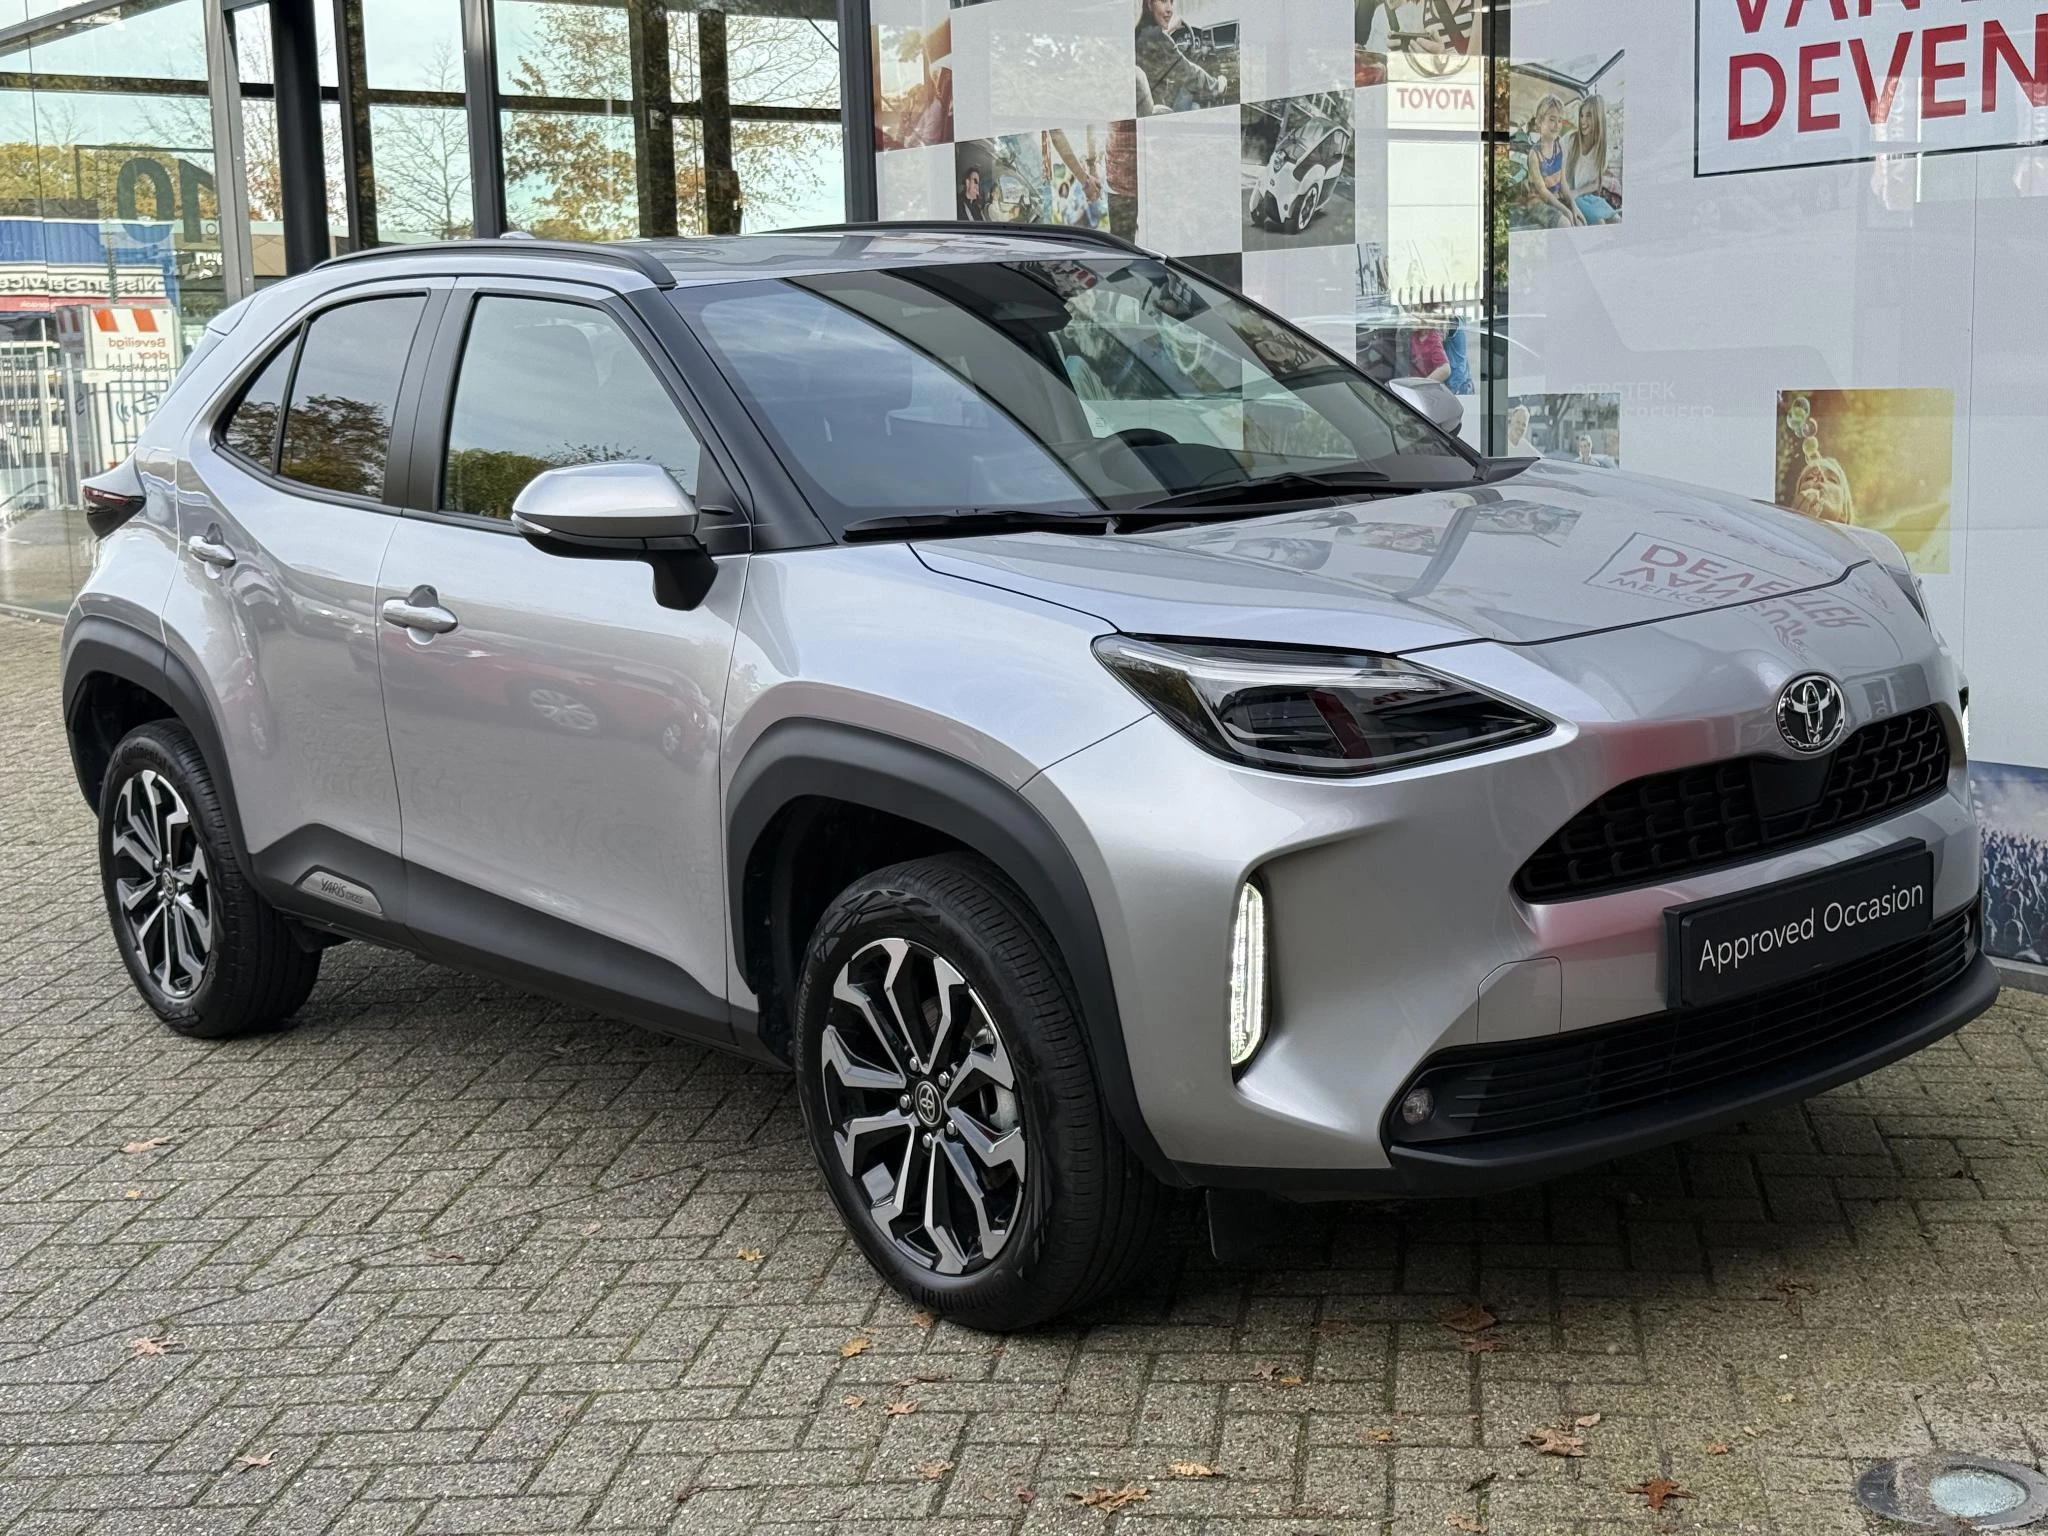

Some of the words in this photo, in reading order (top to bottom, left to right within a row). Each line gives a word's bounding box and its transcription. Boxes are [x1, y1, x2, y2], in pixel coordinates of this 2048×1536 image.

[1396, 87, 1475, 110] TOYOTA
[1728, 14, 2048, 140] DEVEN
[1698, 907, 1815, 974] Approved
[1823, 884, 1924, 933] Occasion
